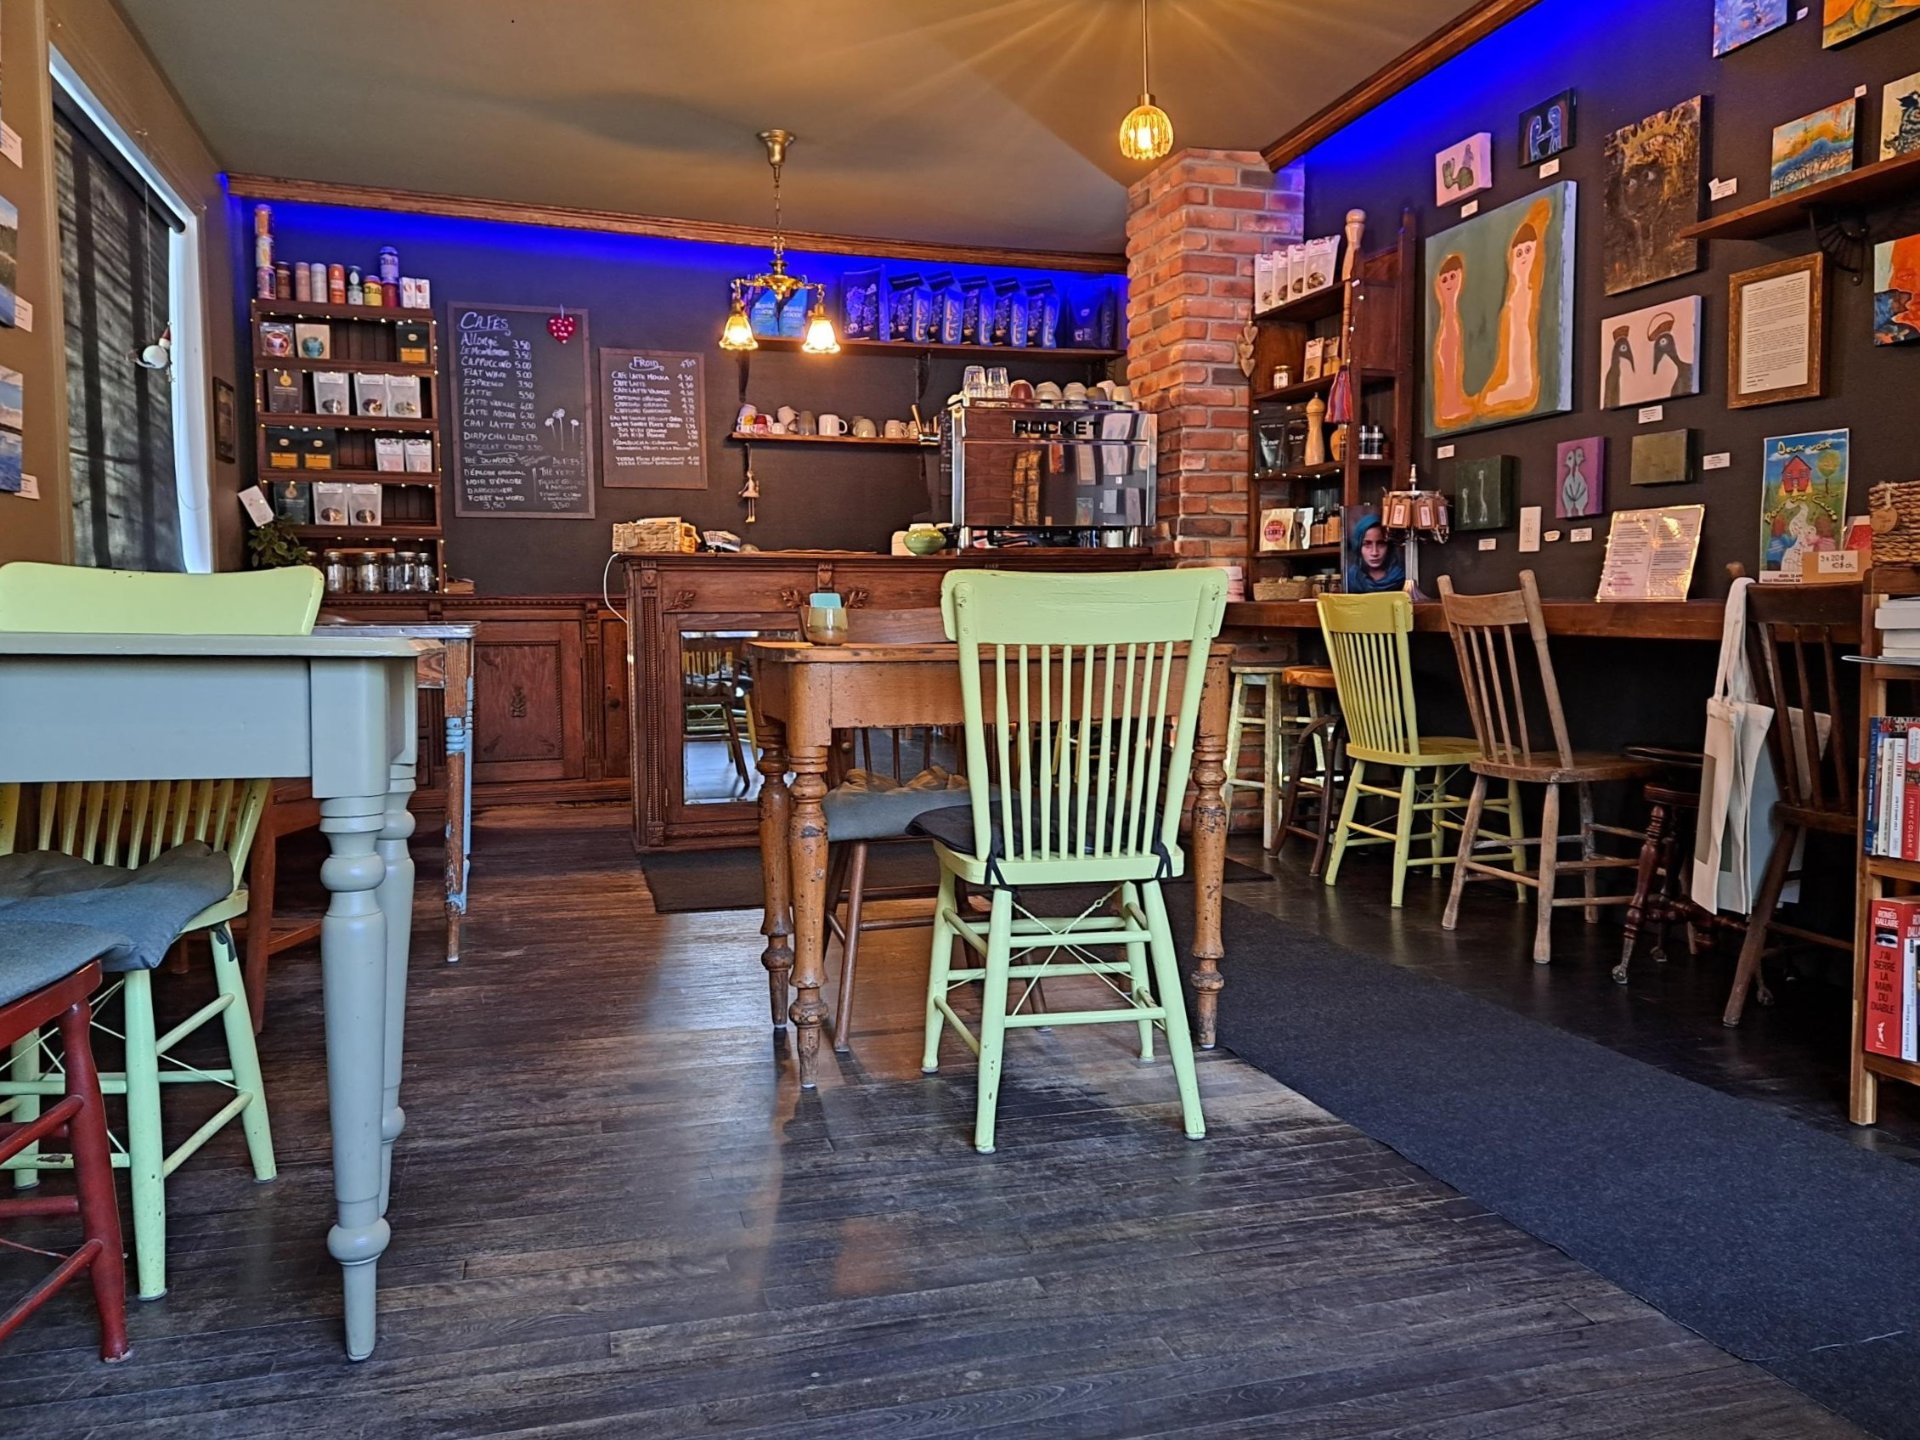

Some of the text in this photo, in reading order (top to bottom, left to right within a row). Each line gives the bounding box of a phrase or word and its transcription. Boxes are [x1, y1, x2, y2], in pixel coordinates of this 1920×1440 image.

[461, 356, 512, 368] CAPPUCCINO
[633, 356, 659, 367] FROID
[463, 368, 484, 377] FLAT
[463, 379, 504, 387] ESPRESSO
[464, 388, 492, 397] LATTE
[463, 397, 488, 406] LATTE
[464, 406, 488, 416] LATTE
[463, 419, 484, 427] CHAI
[489, 421, 515, 429] LATTE
[1013, 420, 1099, 435] ROCKET
[463, 432, 488, 441] DIRTY
[1778, 441, 1805, 454] Deux
[1907, 820, 1915, 848] COLGAN
[1875, 917, 1899, 928] DALLAIRE
[1880, 972, 1889, 981] LA
[1874, 981, 1893, 992] MAIN
[1878, 992, 1889, 1002] DU
[1871, 1001, 1895, 1014] DIABLE
